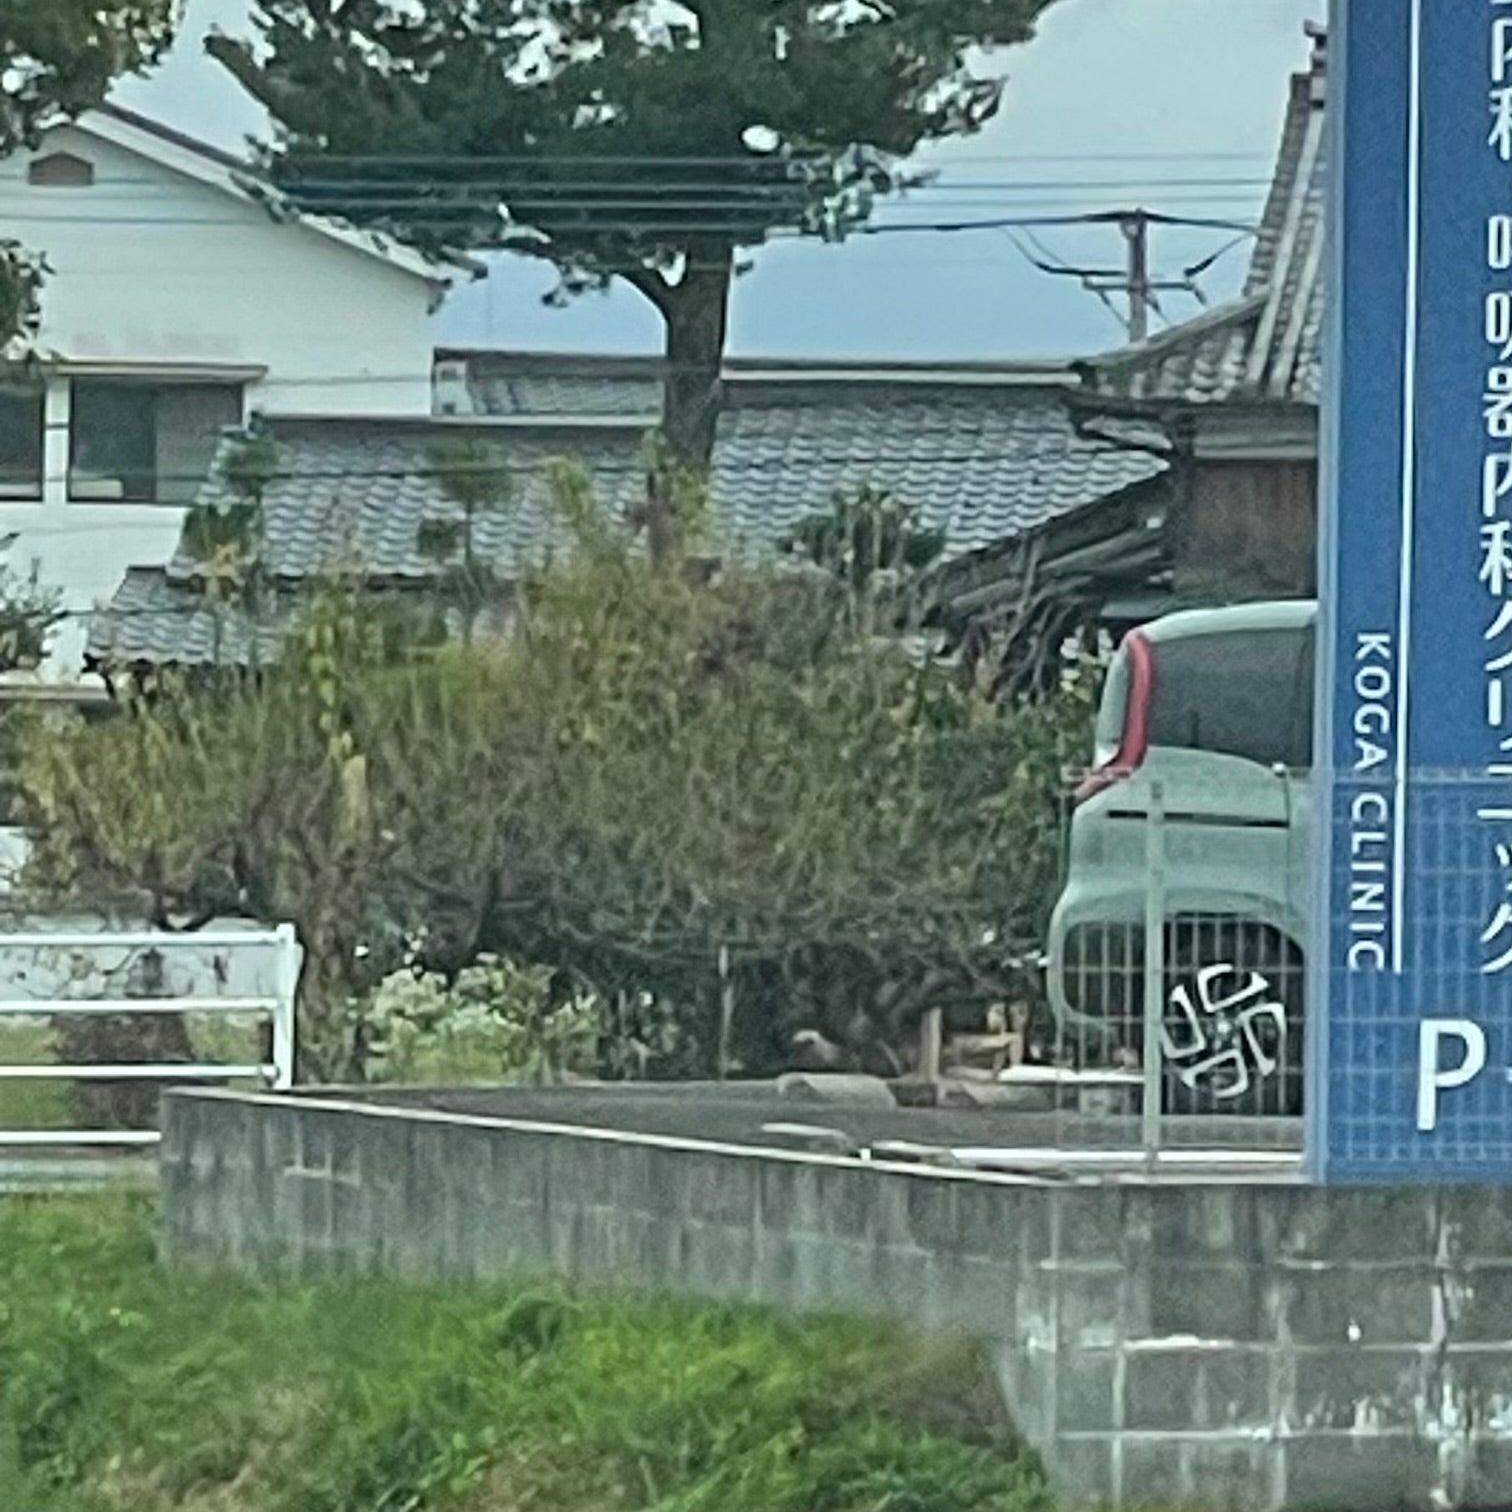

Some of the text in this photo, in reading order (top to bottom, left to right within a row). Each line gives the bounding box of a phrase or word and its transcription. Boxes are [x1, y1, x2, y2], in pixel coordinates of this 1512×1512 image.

[1348, 632, 1392, 973] KOGA CLINIC
[1416, 1018, 1487, 1131] P
